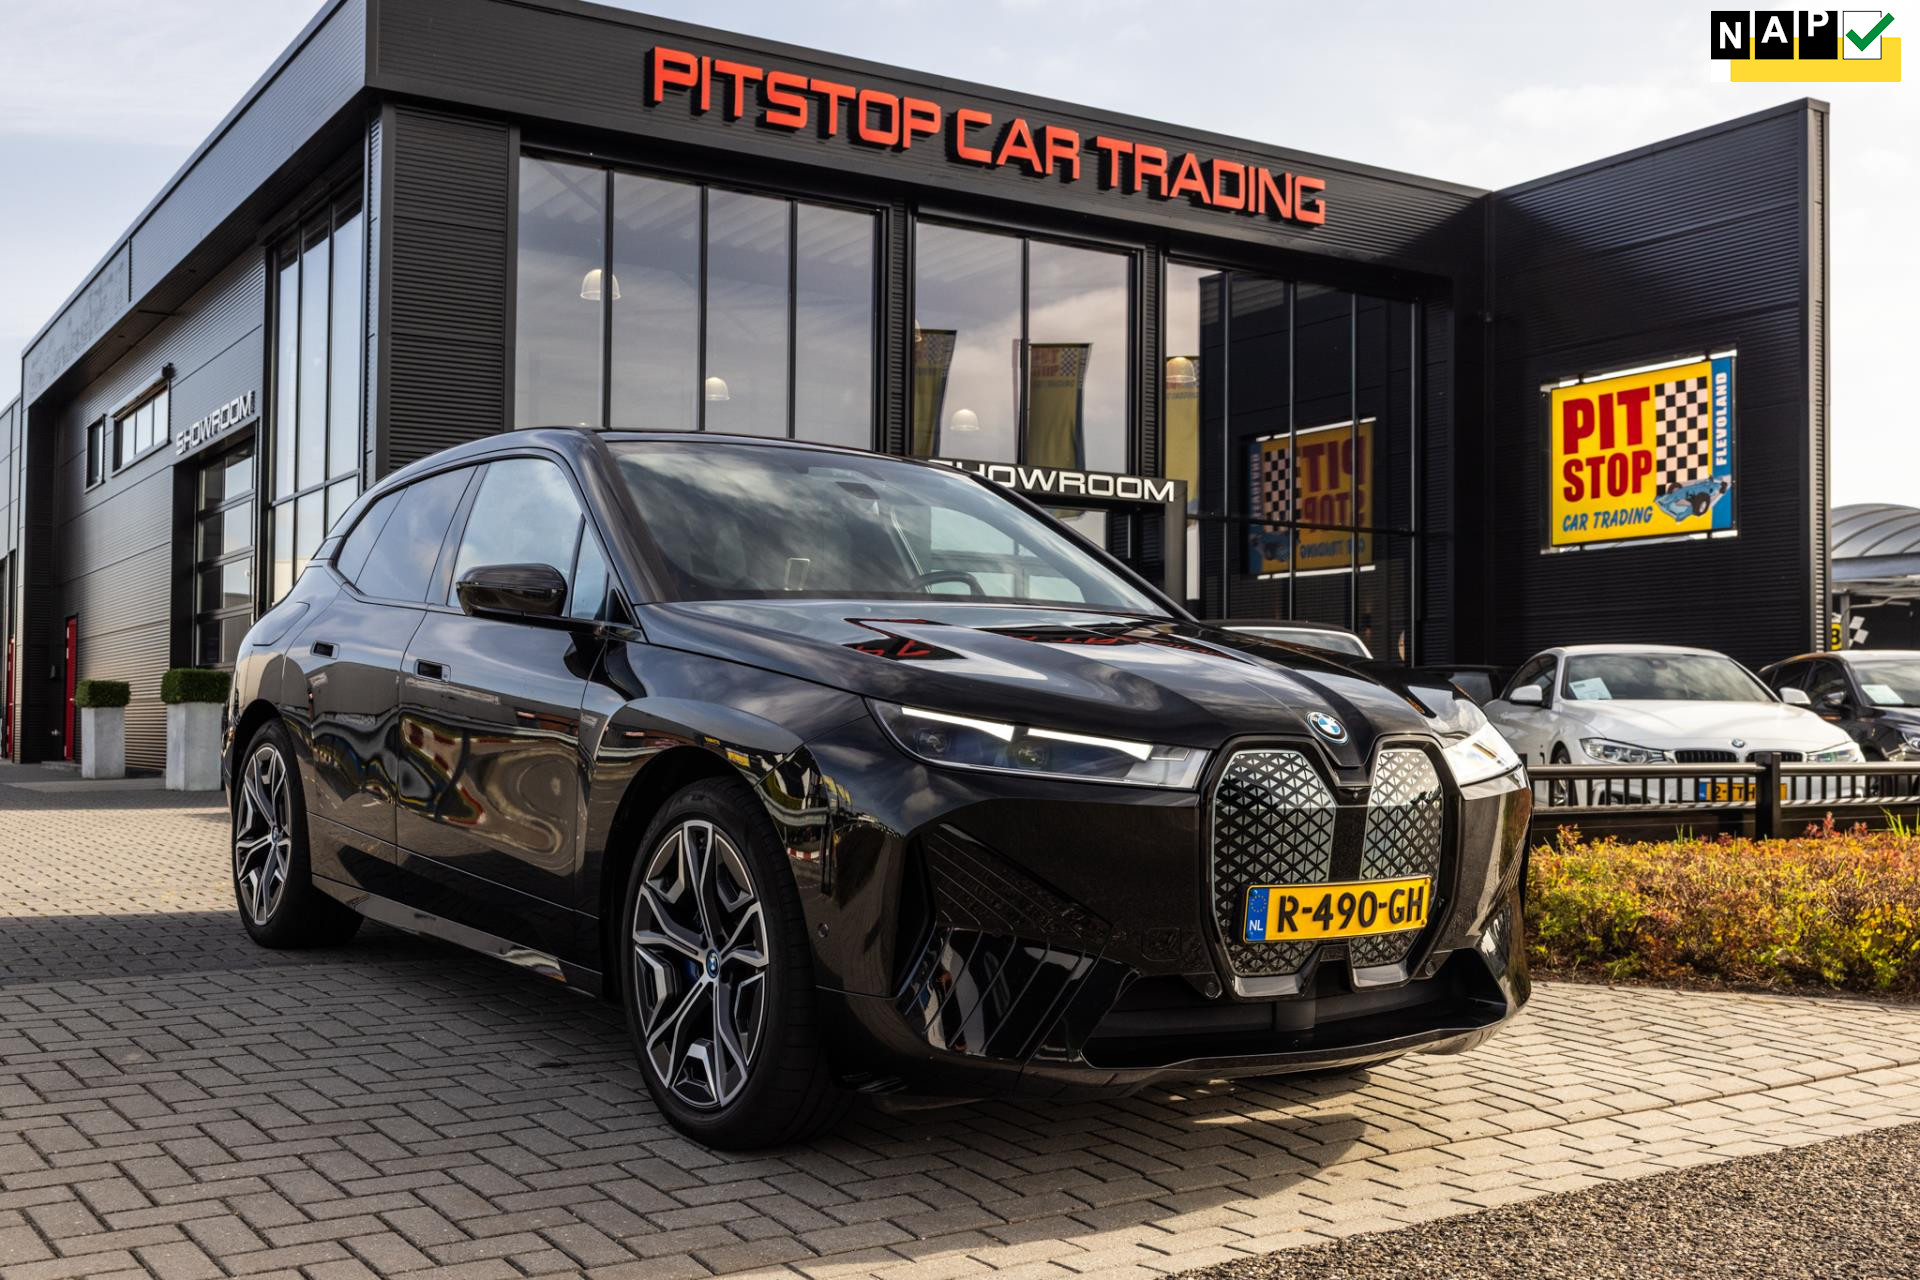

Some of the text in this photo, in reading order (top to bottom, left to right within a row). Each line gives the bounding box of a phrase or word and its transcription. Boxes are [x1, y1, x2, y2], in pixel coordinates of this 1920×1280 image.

[653, 45, 1326, 226] PITSTOP CAR TRADING
[175, 389, 254, 456] SHOWROOM
[1562, 385, 1651, 456] PIT
[1714, 371, 1728, 466] FLEVOLAND
[1562, 449, 1653, 503] STOP
[1562, 505, 1654, 532] CAR TRADING
[1248, 886, 1425, 933] NL R-490-GH
